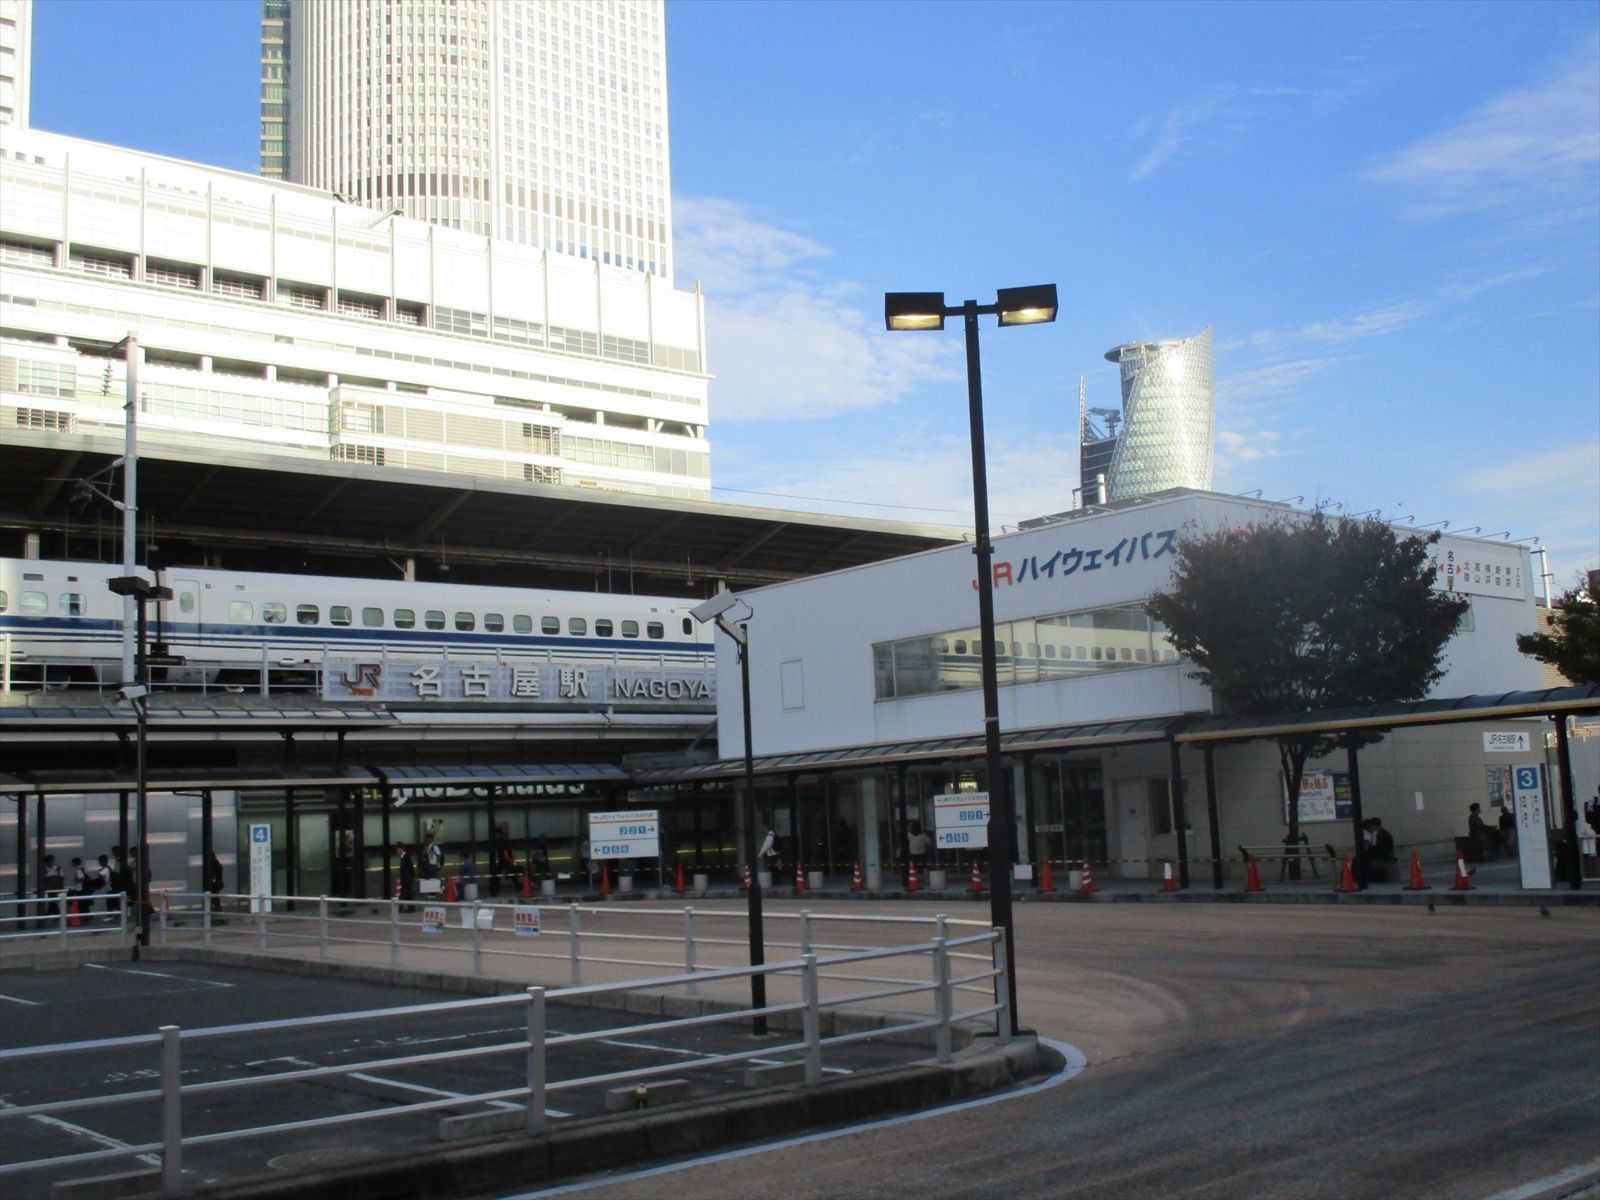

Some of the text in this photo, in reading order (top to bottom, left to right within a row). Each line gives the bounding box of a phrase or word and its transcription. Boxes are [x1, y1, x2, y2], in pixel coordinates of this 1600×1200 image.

[340, 663, 381, 689] JR
[410, 665, 588, 697] 名古屋駅
[613, 677, 711, 699] NAGOYA
[1521, 770, 1533, 787] 3
[392, 783, 586, 798] McDonads
[255, 829, 265, 841] 4
